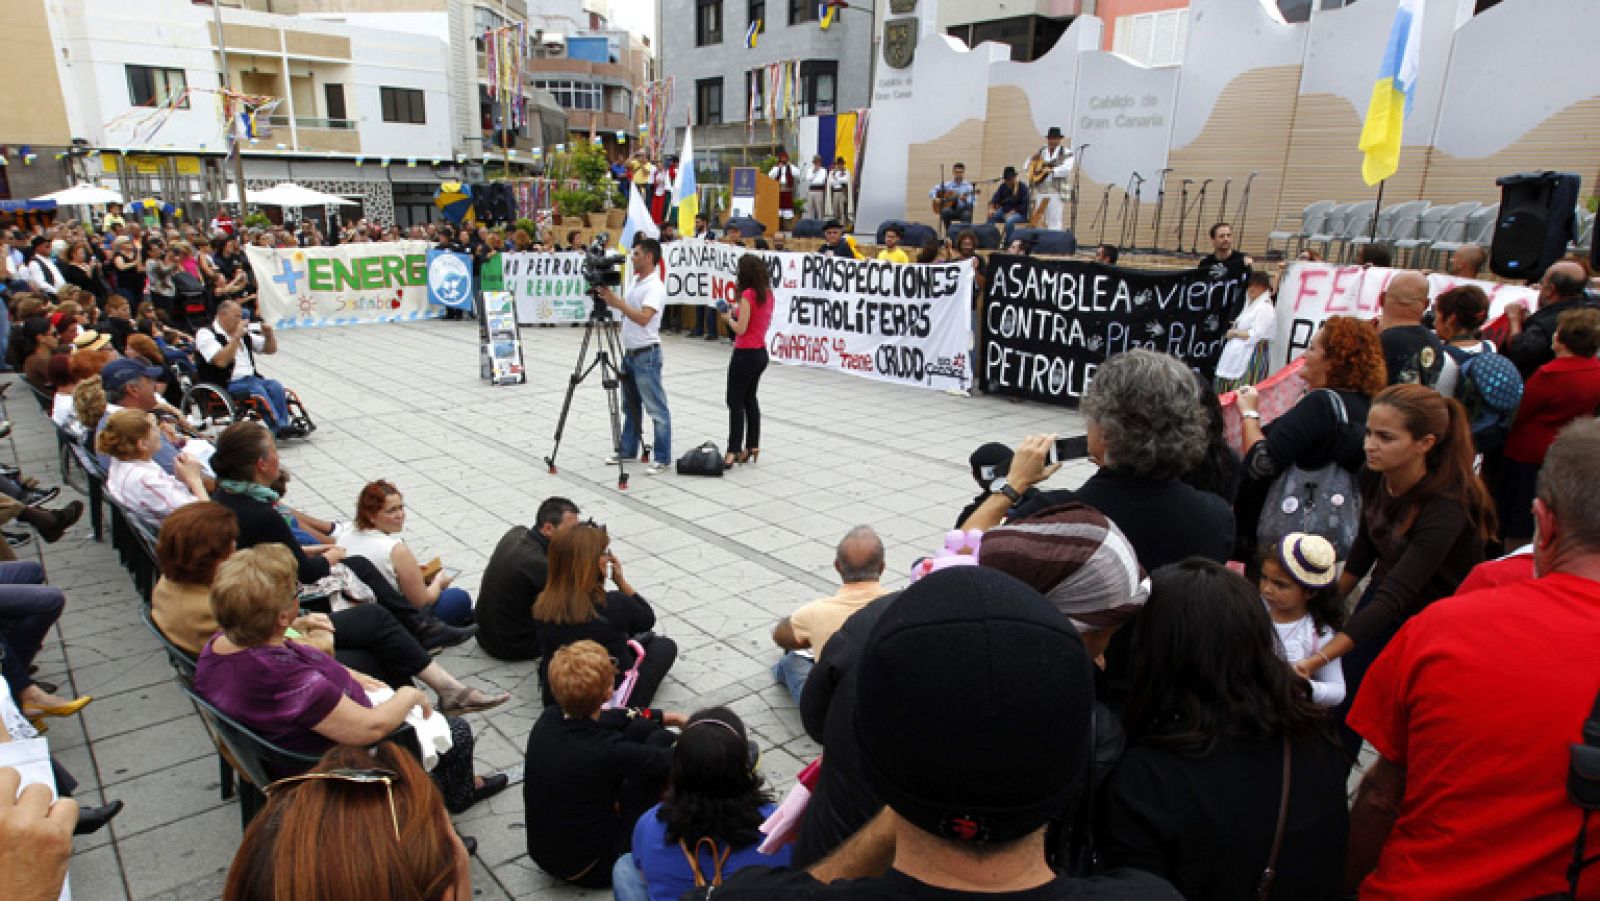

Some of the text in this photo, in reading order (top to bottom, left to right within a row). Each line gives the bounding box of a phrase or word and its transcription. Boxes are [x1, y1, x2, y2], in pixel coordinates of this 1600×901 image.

[1080, 113, 1165, 130] Gran Canaria
[1088, 95, 1135, 110] Cabildo
[711, 274, 737, 304] NO
[801, 254, 961, 300] PROSPECCIONES
[989, 262, 1133, 313] ASAMBLEA
[986, 302, 1087, 347] CONTRA
[875, 343, 924, 381] CRUDO
